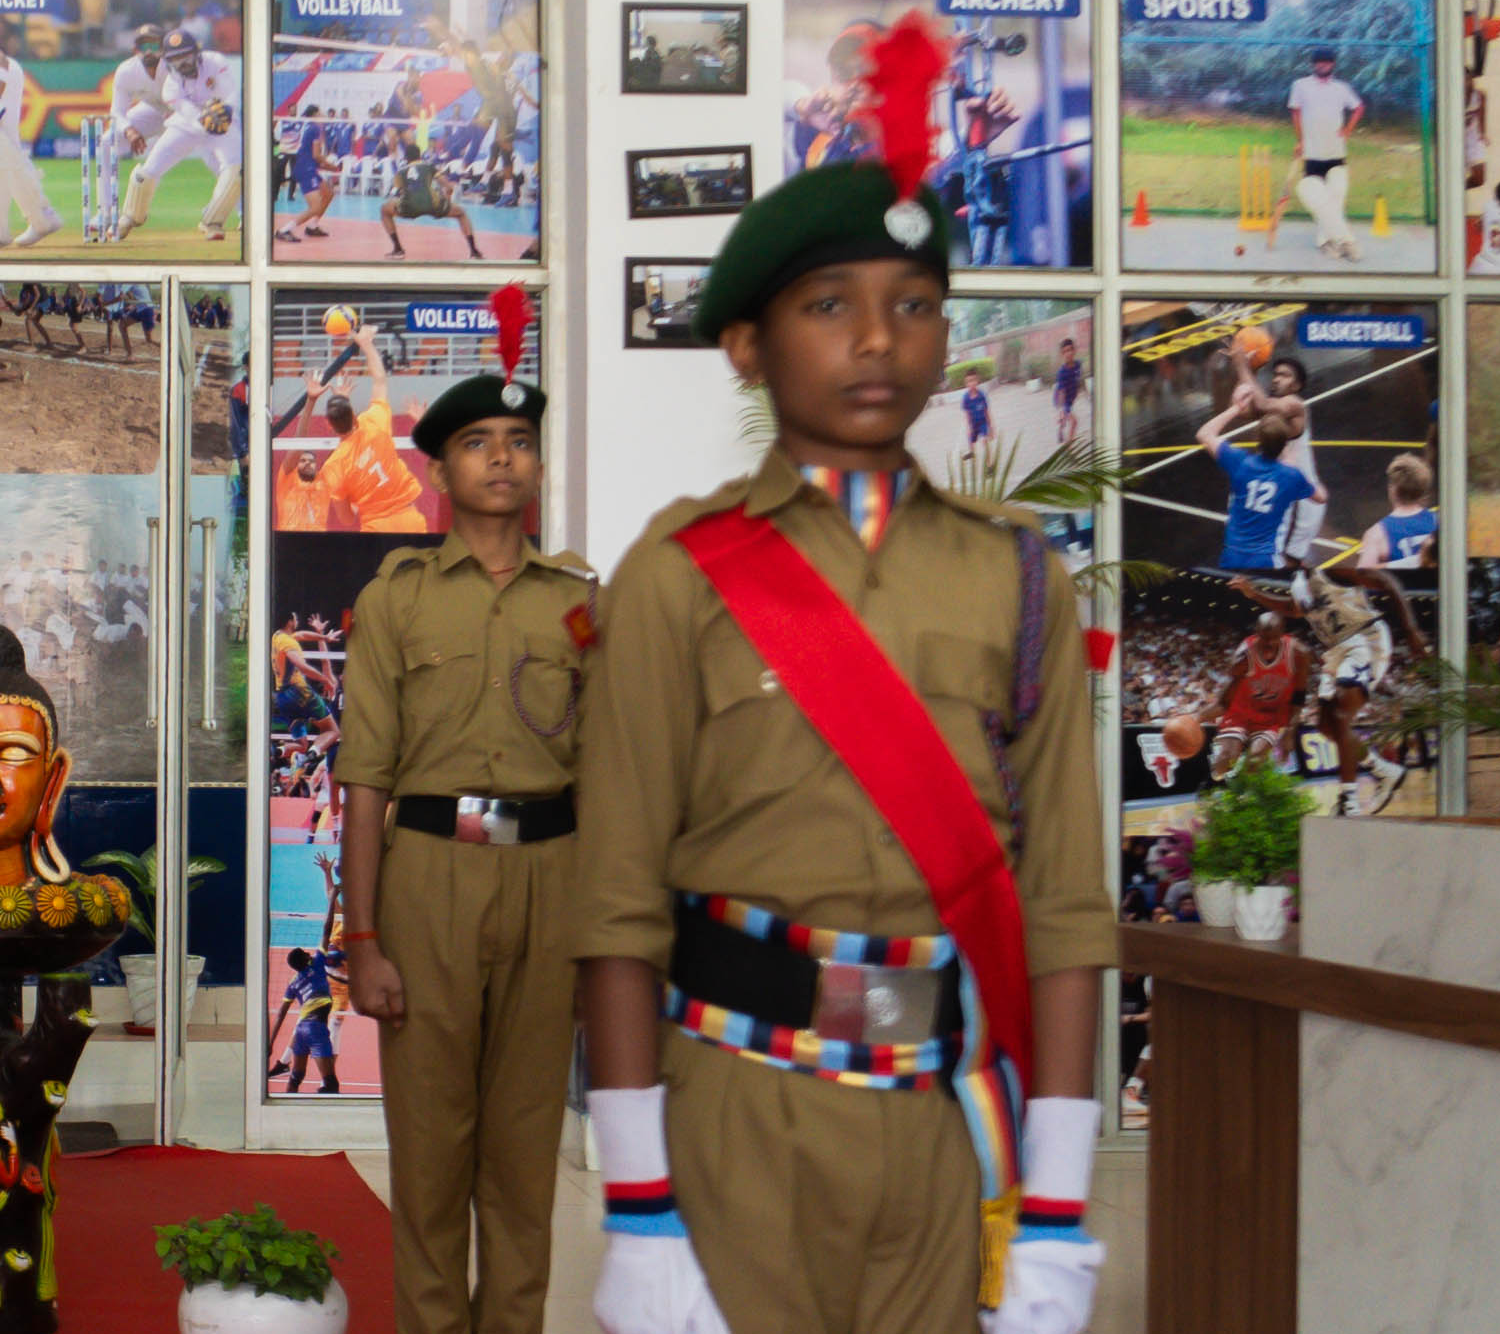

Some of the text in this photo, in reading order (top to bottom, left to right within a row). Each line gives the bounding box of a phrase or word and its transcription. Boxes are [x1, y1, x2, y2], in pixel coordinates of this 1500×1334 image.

[413, 307, 500, 329] VOLLEYBA
[1307, 320, 1415, 343] BASKETBALL
[1244, 478, 1278, 512] 12
